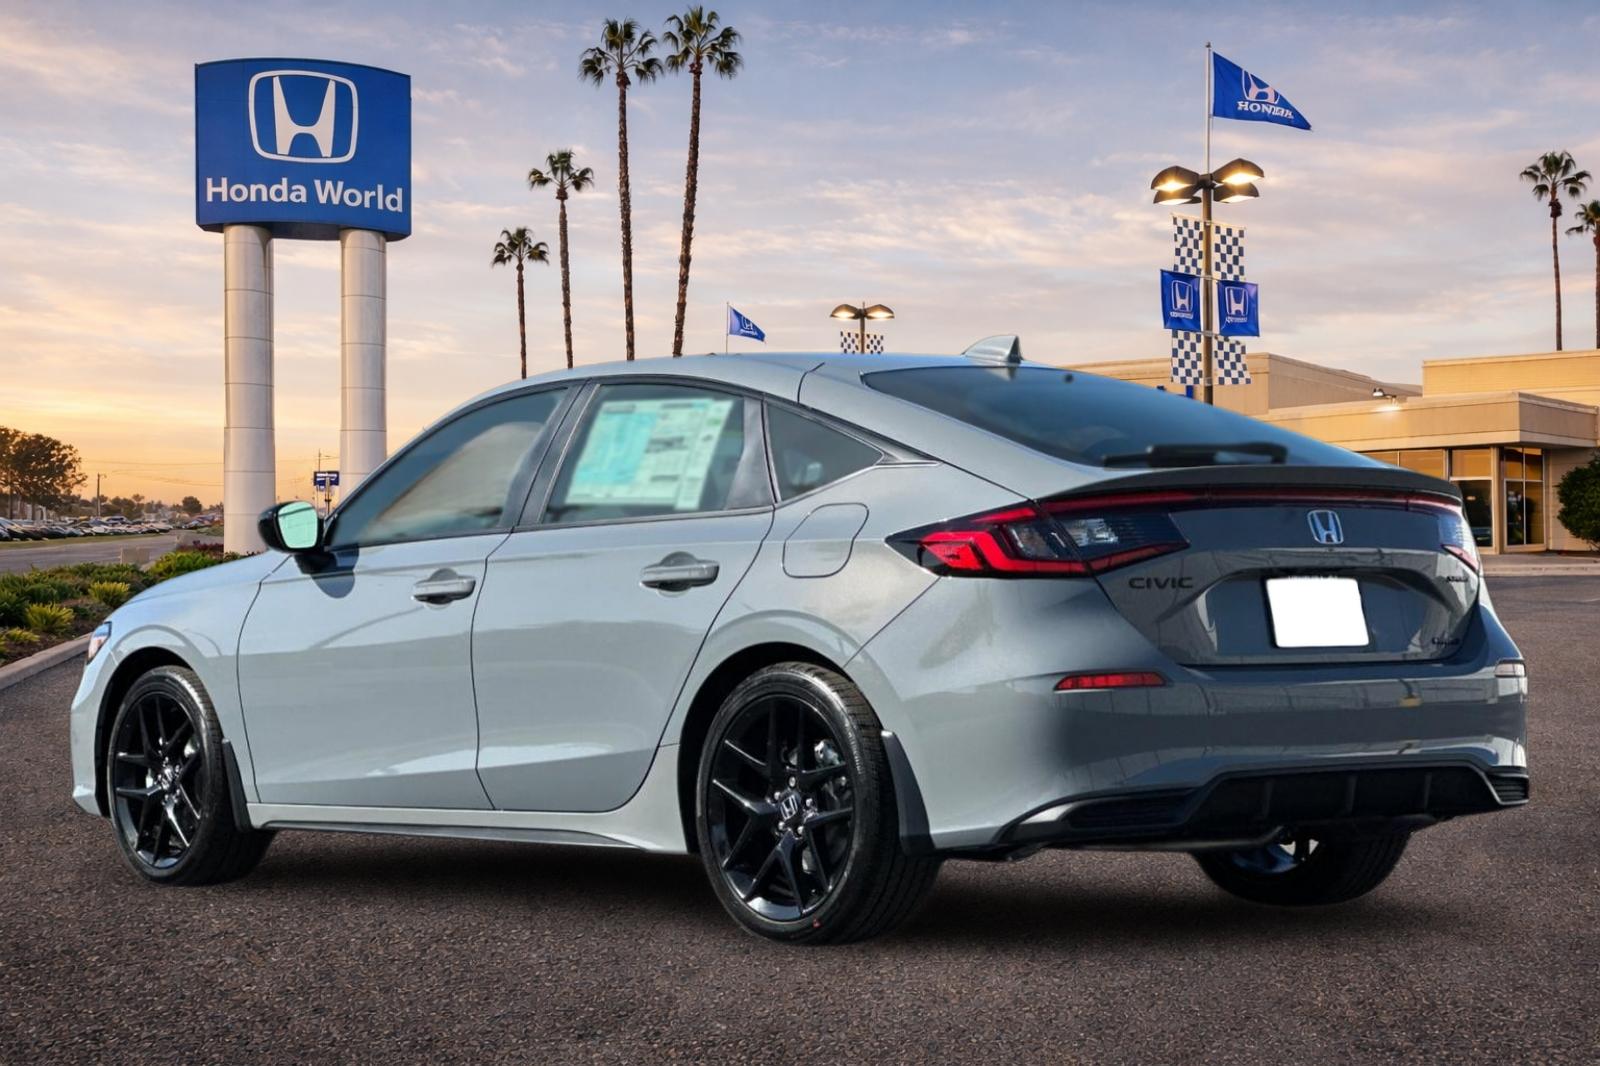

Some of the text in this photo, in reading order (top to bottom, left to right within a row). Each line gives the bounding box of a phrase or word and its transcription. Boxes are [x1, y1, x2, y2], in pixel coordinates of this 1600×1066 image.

[206, 177, 403, 212] Honda World
[1128, 577, 1193, 590] CIVIC
